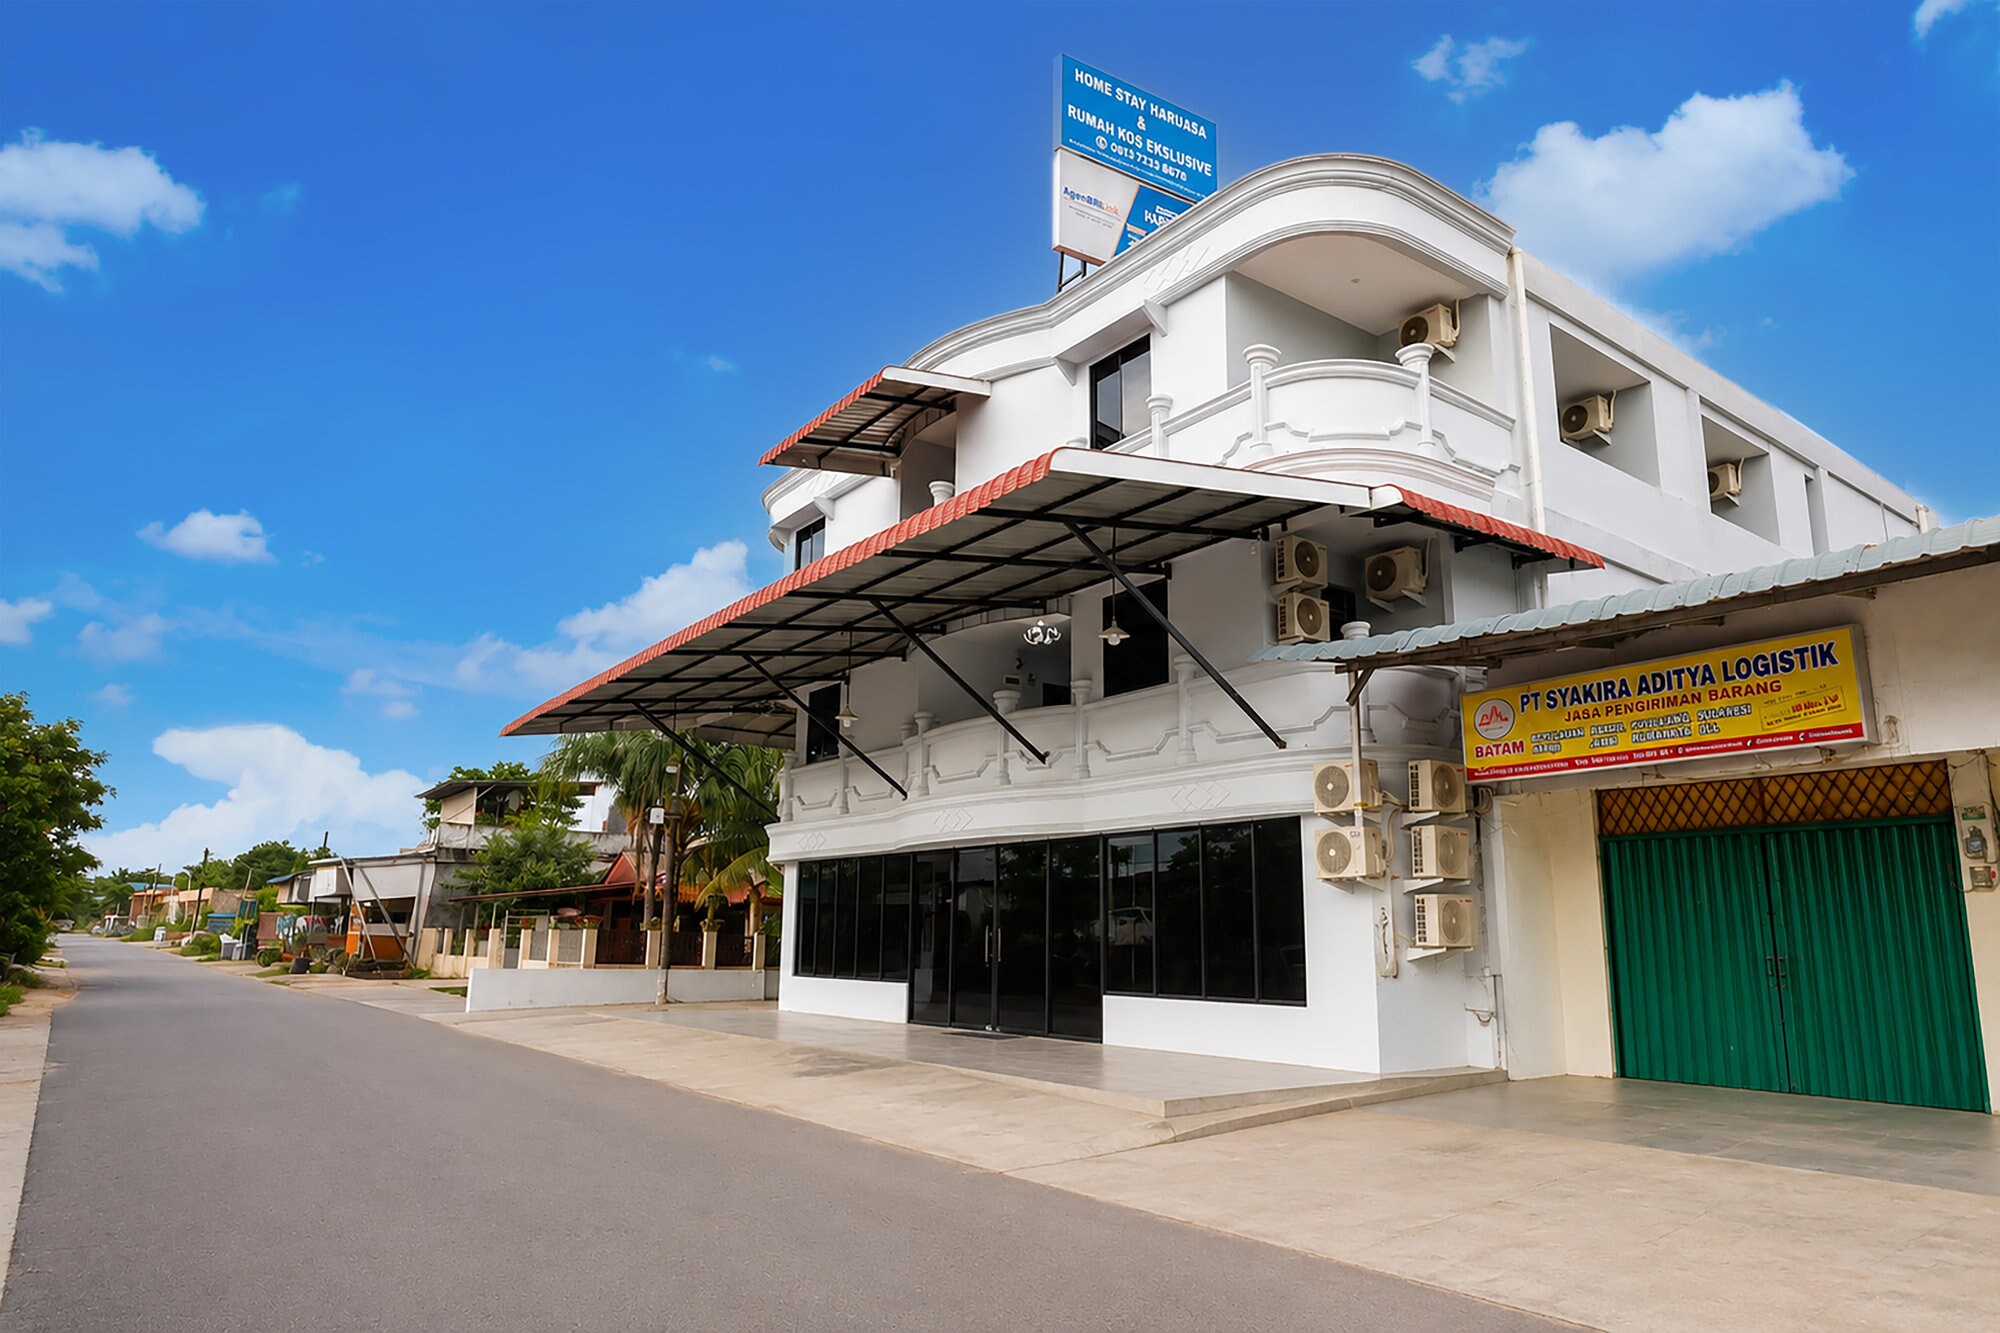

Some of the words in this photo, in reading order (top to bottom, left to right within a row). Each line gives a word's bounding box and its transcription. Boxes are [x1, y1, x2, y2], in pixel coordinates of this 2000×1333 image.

[1074, 68, 1112, 97] HOME
[1115, 87, 1147, 111] STAY
[1150, 102, 1207, 140] HARUASA
[1136, 115, 1147, 131] &
[1068, 104, 1115, 136] RUMAH
[1117, 126, 1144, 149] KOS
[1146, 139, 1213, 177] EKSLUSIVE
[1520, 692, 1541, 713] PT
[1545, 676, 1632, 709] SYAKIRA
[1637, 663, 1716, 697] ADITYA
[1721, 641, 1839, 682] LOGISTIK
[1565, 708, 1601, 722] JASA
[1605, 692, 1702, 717] PENGIRIMAN
[1709, 680, 1782, 701] BARANG
[1475, 741, 1525, 758] BATAM
